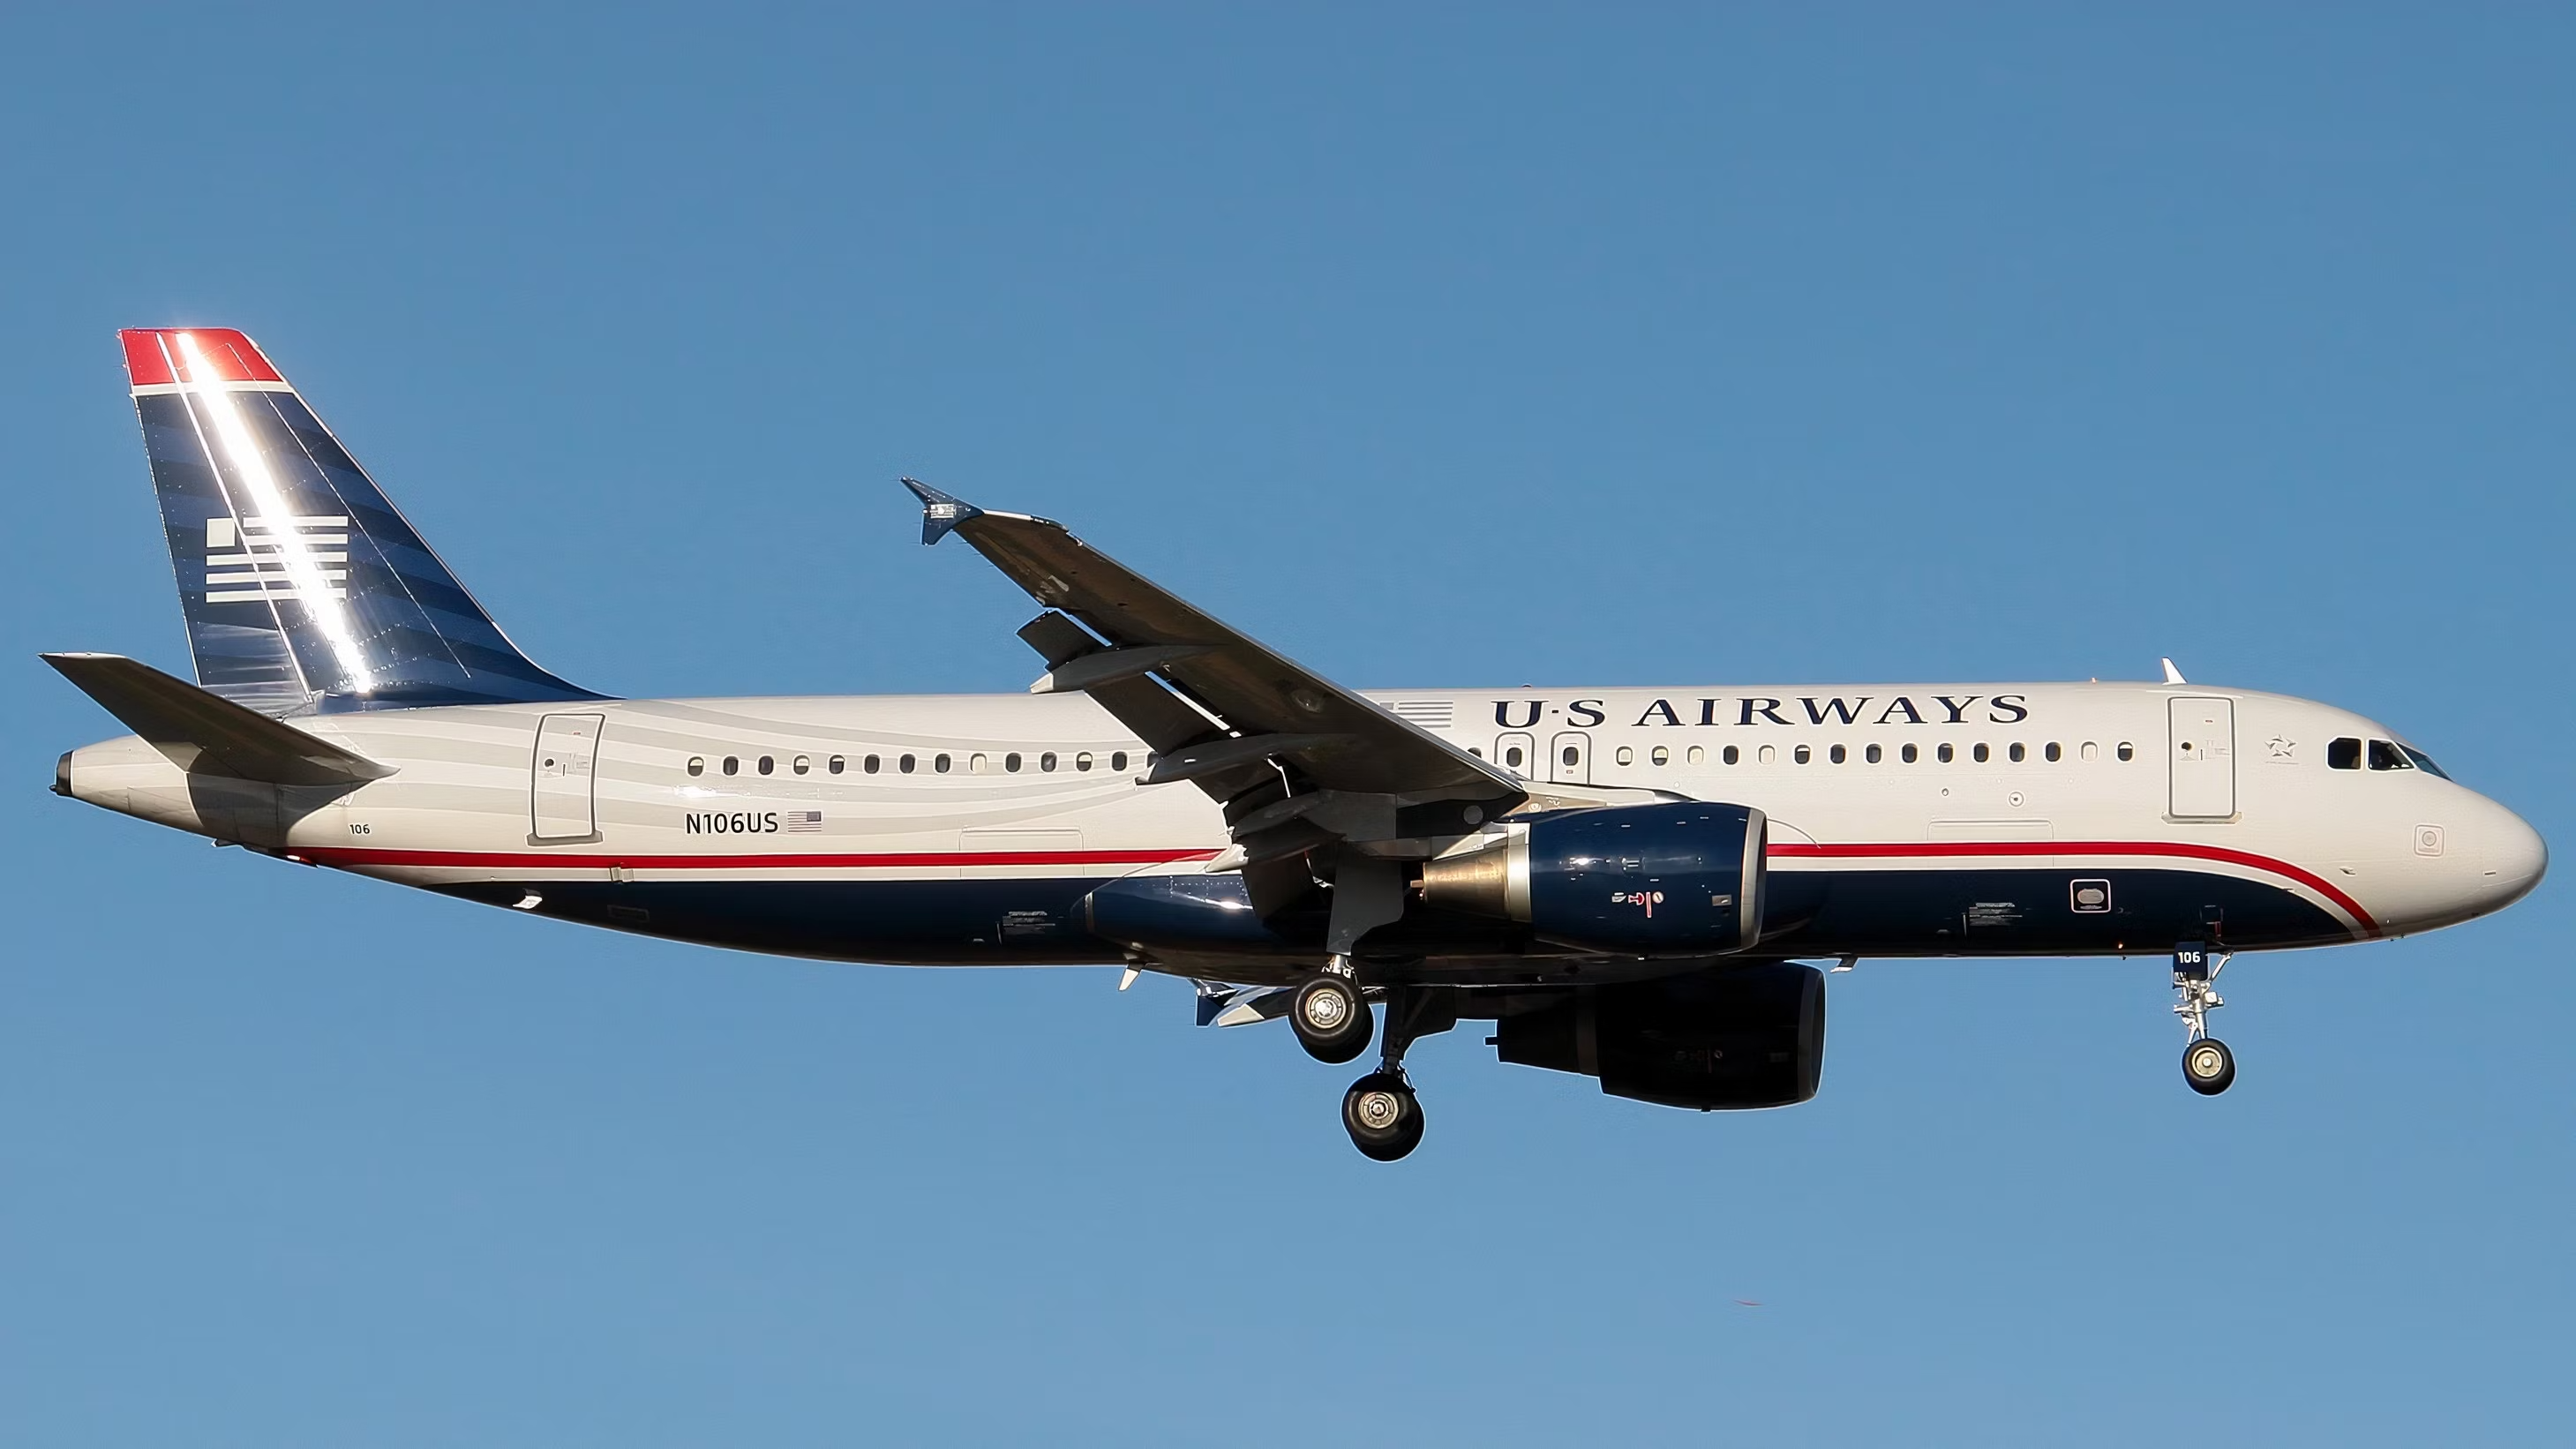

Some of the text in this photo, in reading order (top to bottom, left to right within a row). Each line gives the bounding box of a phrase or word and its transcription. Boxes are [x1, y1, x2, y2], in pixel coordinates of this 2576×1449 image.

[1631, 694, 2029, 726] AIRWAYS
[349, 823, 371, 835] 106
[686, 812, 778, 834] N106US
[2177, 950, 2201, 964] 106
